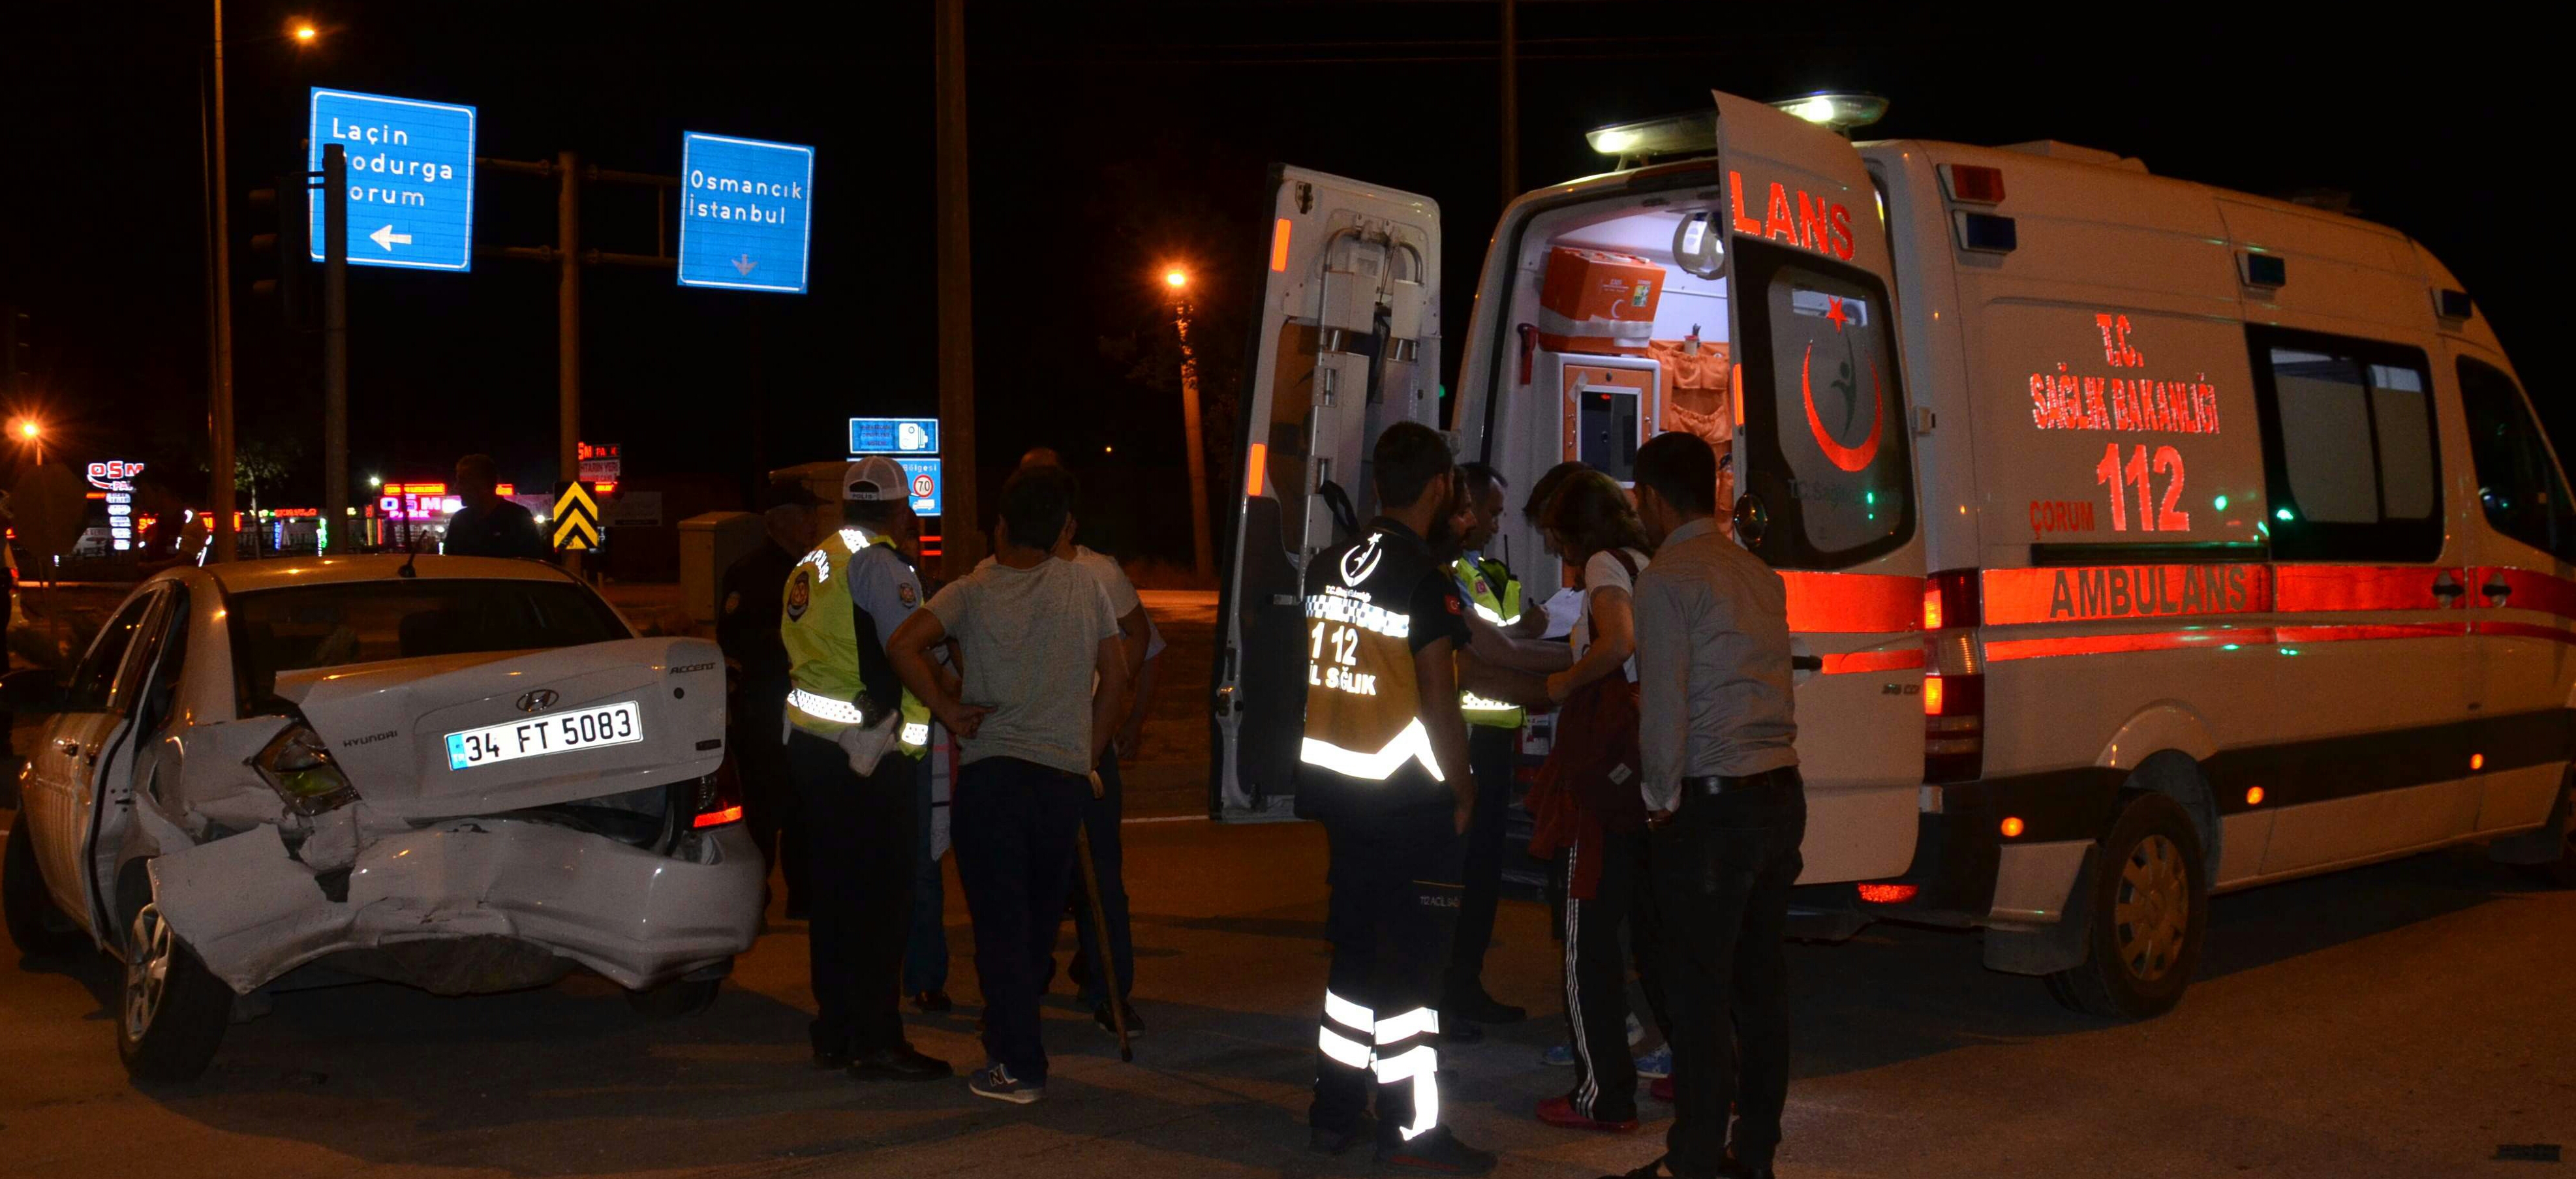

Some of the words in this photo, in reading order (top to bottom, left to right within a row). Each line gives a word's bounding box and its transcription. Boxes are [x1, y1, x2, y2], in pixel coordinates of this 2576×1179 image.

[333, 117, 408, 145] Laçin
[343, 153, 453, 183] odurga
[350, 186, 424, 206] orum
[691, 170, 802, 200] Osmancık
[1729, 171, 1854, 261] LANS
[2096, 314, 2143, 367] T.C.
[2030, 362, 2111, 430] SAĞLIK
[2112, 373, 2220, 434] BAKANLIĞI
[918, 480, 930, 492] 70
[2097, 443, 2190, 531] 112
[2030, 500, 2095, 540] ÇORUM
[2050, 566, 2247, 619] AMBULANS
[669, 662, 716, 675] ACCENT
[1309, 660, 1321, 686] İL
[344, 730, 397, 746] HYUNDAI
[466, 733, 500, 761] 34
[517, 722, 548, 752] FT
[562, 709, 631, 745] 5083
